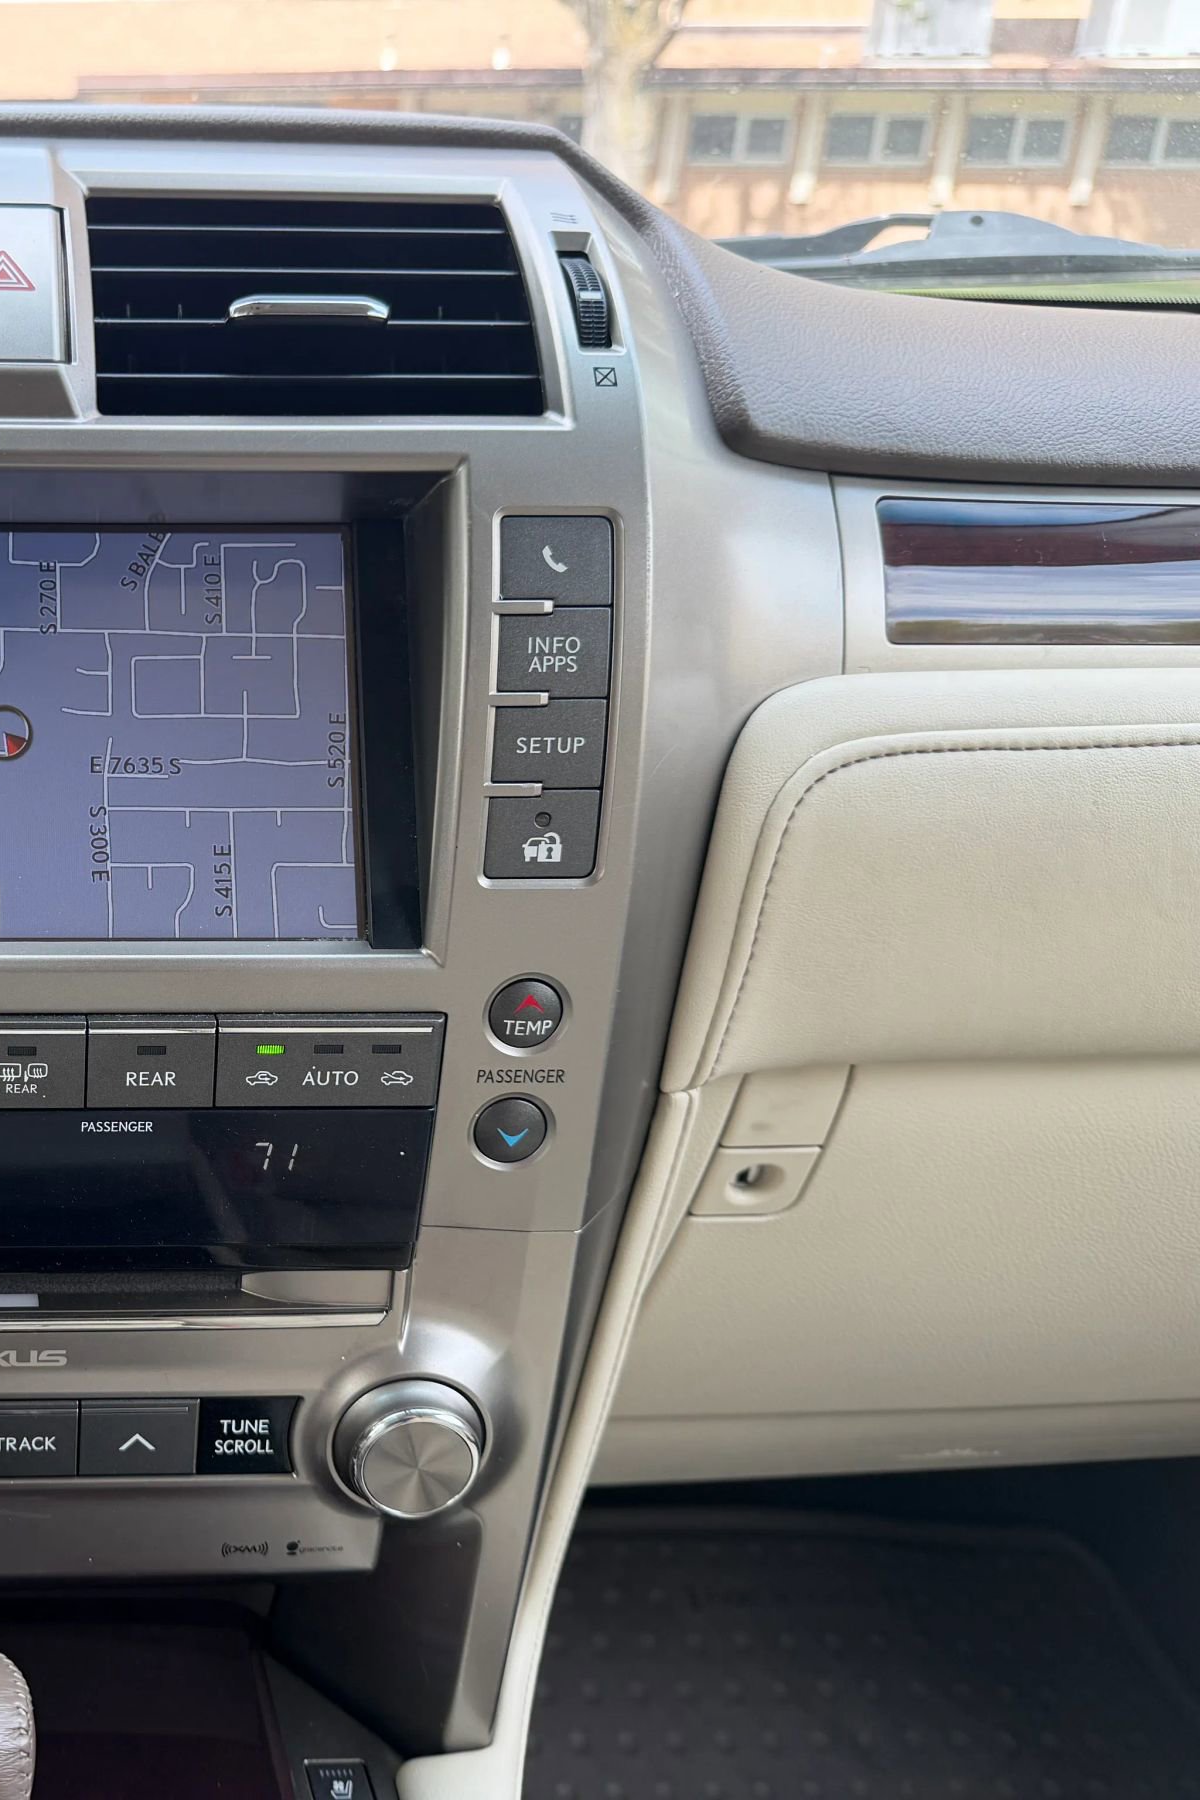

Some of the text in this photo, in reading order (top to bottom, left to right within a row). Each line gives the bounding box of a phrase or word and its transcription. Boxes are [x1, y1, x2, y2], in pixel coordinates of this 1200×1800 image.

[120, 576, 138, 592] S
[204, 555, 222, 625] S 410 E
[39, 561, 57, 635] S 270 E
[528, 637, 581, 653] INFO
[528, 656, 578, 673] APPS
[327, 712, 346, 788] S 520 E
[516, 737, 585, 754] SETUP
[90, 756, 182, 775] E 7635 S
[89, 806, 111, 883] S 300 E
[213, 844, 233, 917] S 415 E
[503, 1019, 553, 1037] TEMP
[125, 1071, 176, 1087] REAR
[302, 1070, 359, 1086] AUTO
[476, 1068, 565, 1084] PASSENGER
[5, 1083, 38, 1094] REAR
[81, 1121, 153, 1133] PASSENGER
[255, 1141, 298, 1171] 71
[220, 1419, 270, 1435] TUNE
[214, 1439, 274, 1456] SCROLL
